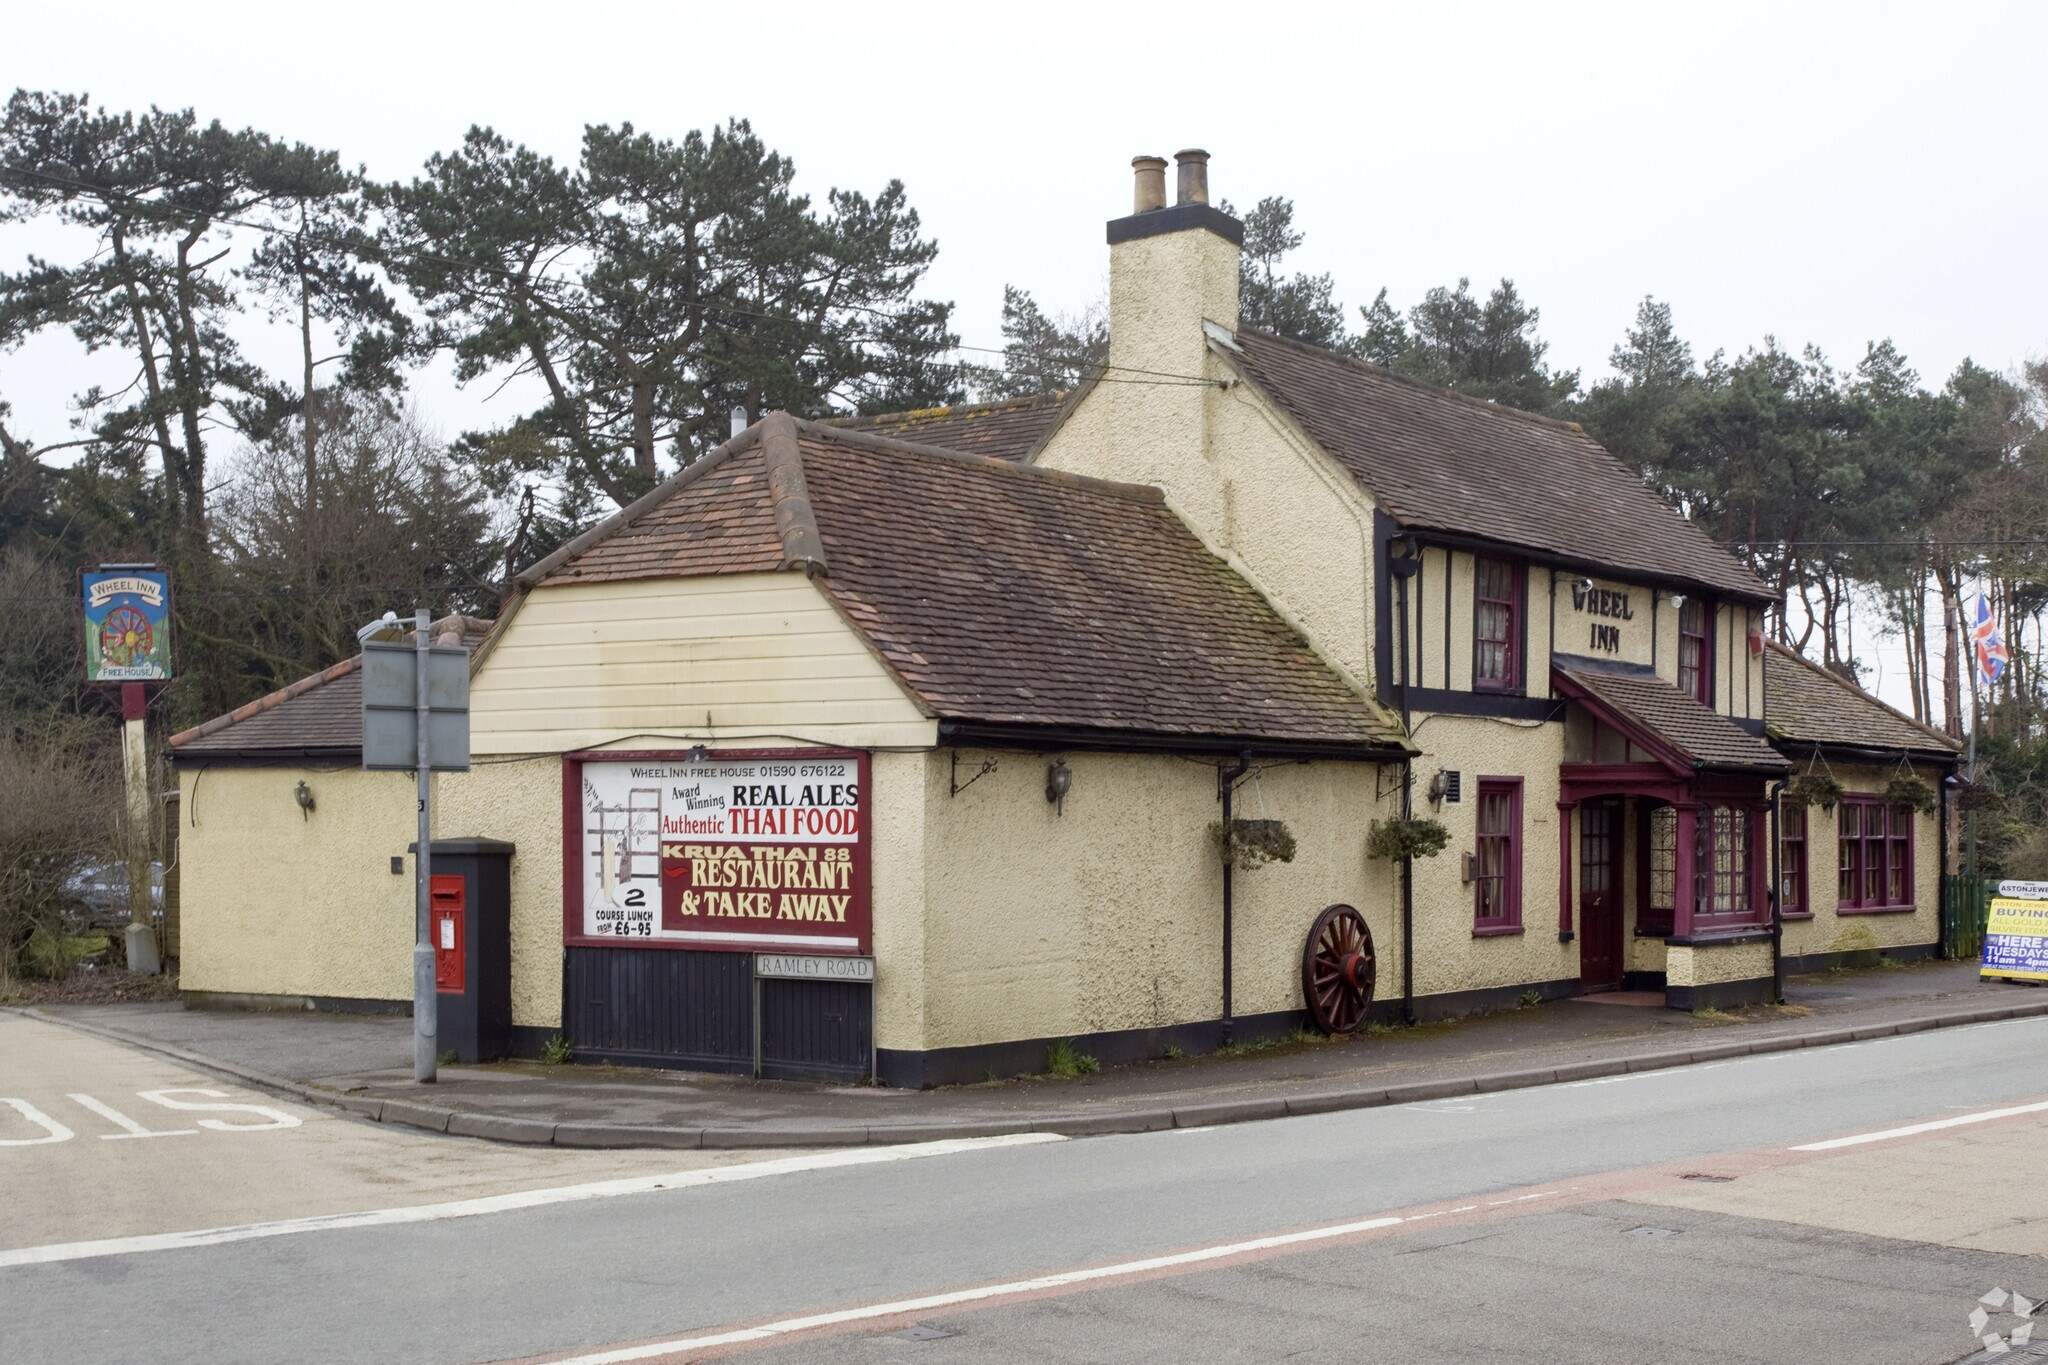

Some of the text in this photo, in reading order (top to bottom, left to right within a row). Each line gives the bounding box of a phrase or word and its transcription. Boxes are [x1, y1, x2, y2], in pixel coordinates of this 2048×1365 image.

[94, 580, 157, 595] WHEEL INN
[1571, 583, 1634, 620] WHEEL
[1590, 623, 1620, 653] INN
[103, 668, 151, 677] FREE HOUSE
[630, 765, 845, 778] WHEEL INN FREE HOUSE 01590 676122
[672, 783, 700, 800] Award
[732, 784, 858, 806] REAL ALES
[686, 795, 725, 810] Winning
[662, 807, 858, 835] Authentic THAI FOOD
[662, 844, 851, 862] KRUA THAI 88
[691, 859, 854, 890] RESTAURANT
[624, 888, 647, 907] 2
[681, 890, 852, 922] & TAKE AWAY
[595, 910, 653, 921] COURSE LUNCH
[2013, 918, 2042, 926] GOLD
[597, 922, 613, 933] FROM
[1989, 925, 2023, 933] SILVER
[1998, 935, 2043, 948] HERE
[1987, 945, 2048, 959] TUESDAYS
[762, 957, 868, 976] RAMLEY ROAD
[1986, 955, 2016, 964] 11am
[2025, 957, 2048, 967] 4pm
